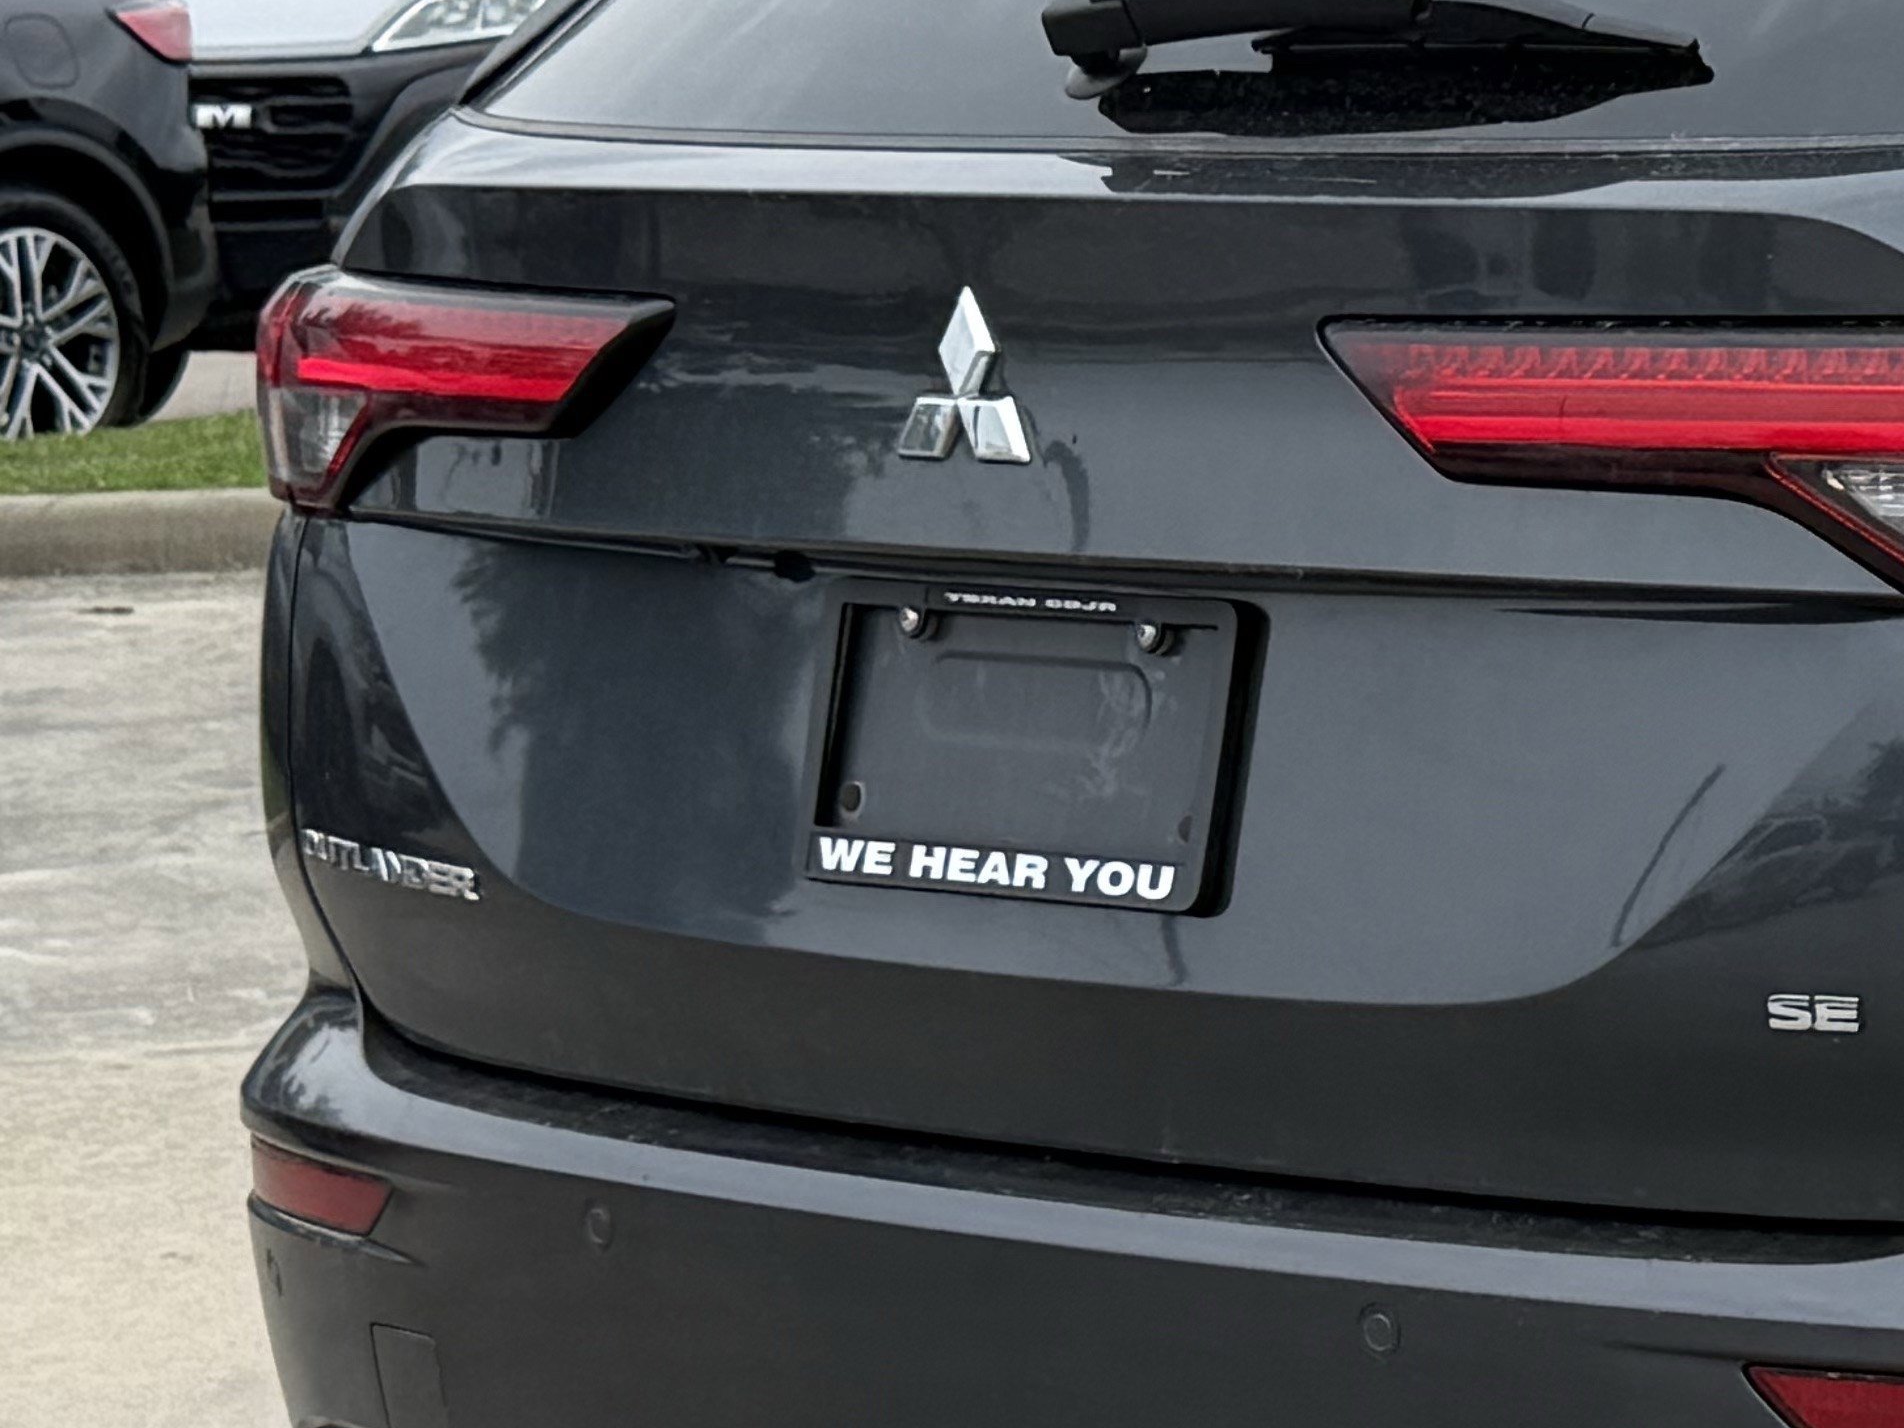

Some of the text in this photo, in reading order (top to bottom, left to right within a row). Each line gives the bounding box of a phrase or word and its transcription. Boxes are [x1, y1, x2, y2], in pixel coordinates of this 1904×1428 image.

[819, 836, 1176, 900] WE HEAR YOU
[1767, 994, 1860, 1033] SE
